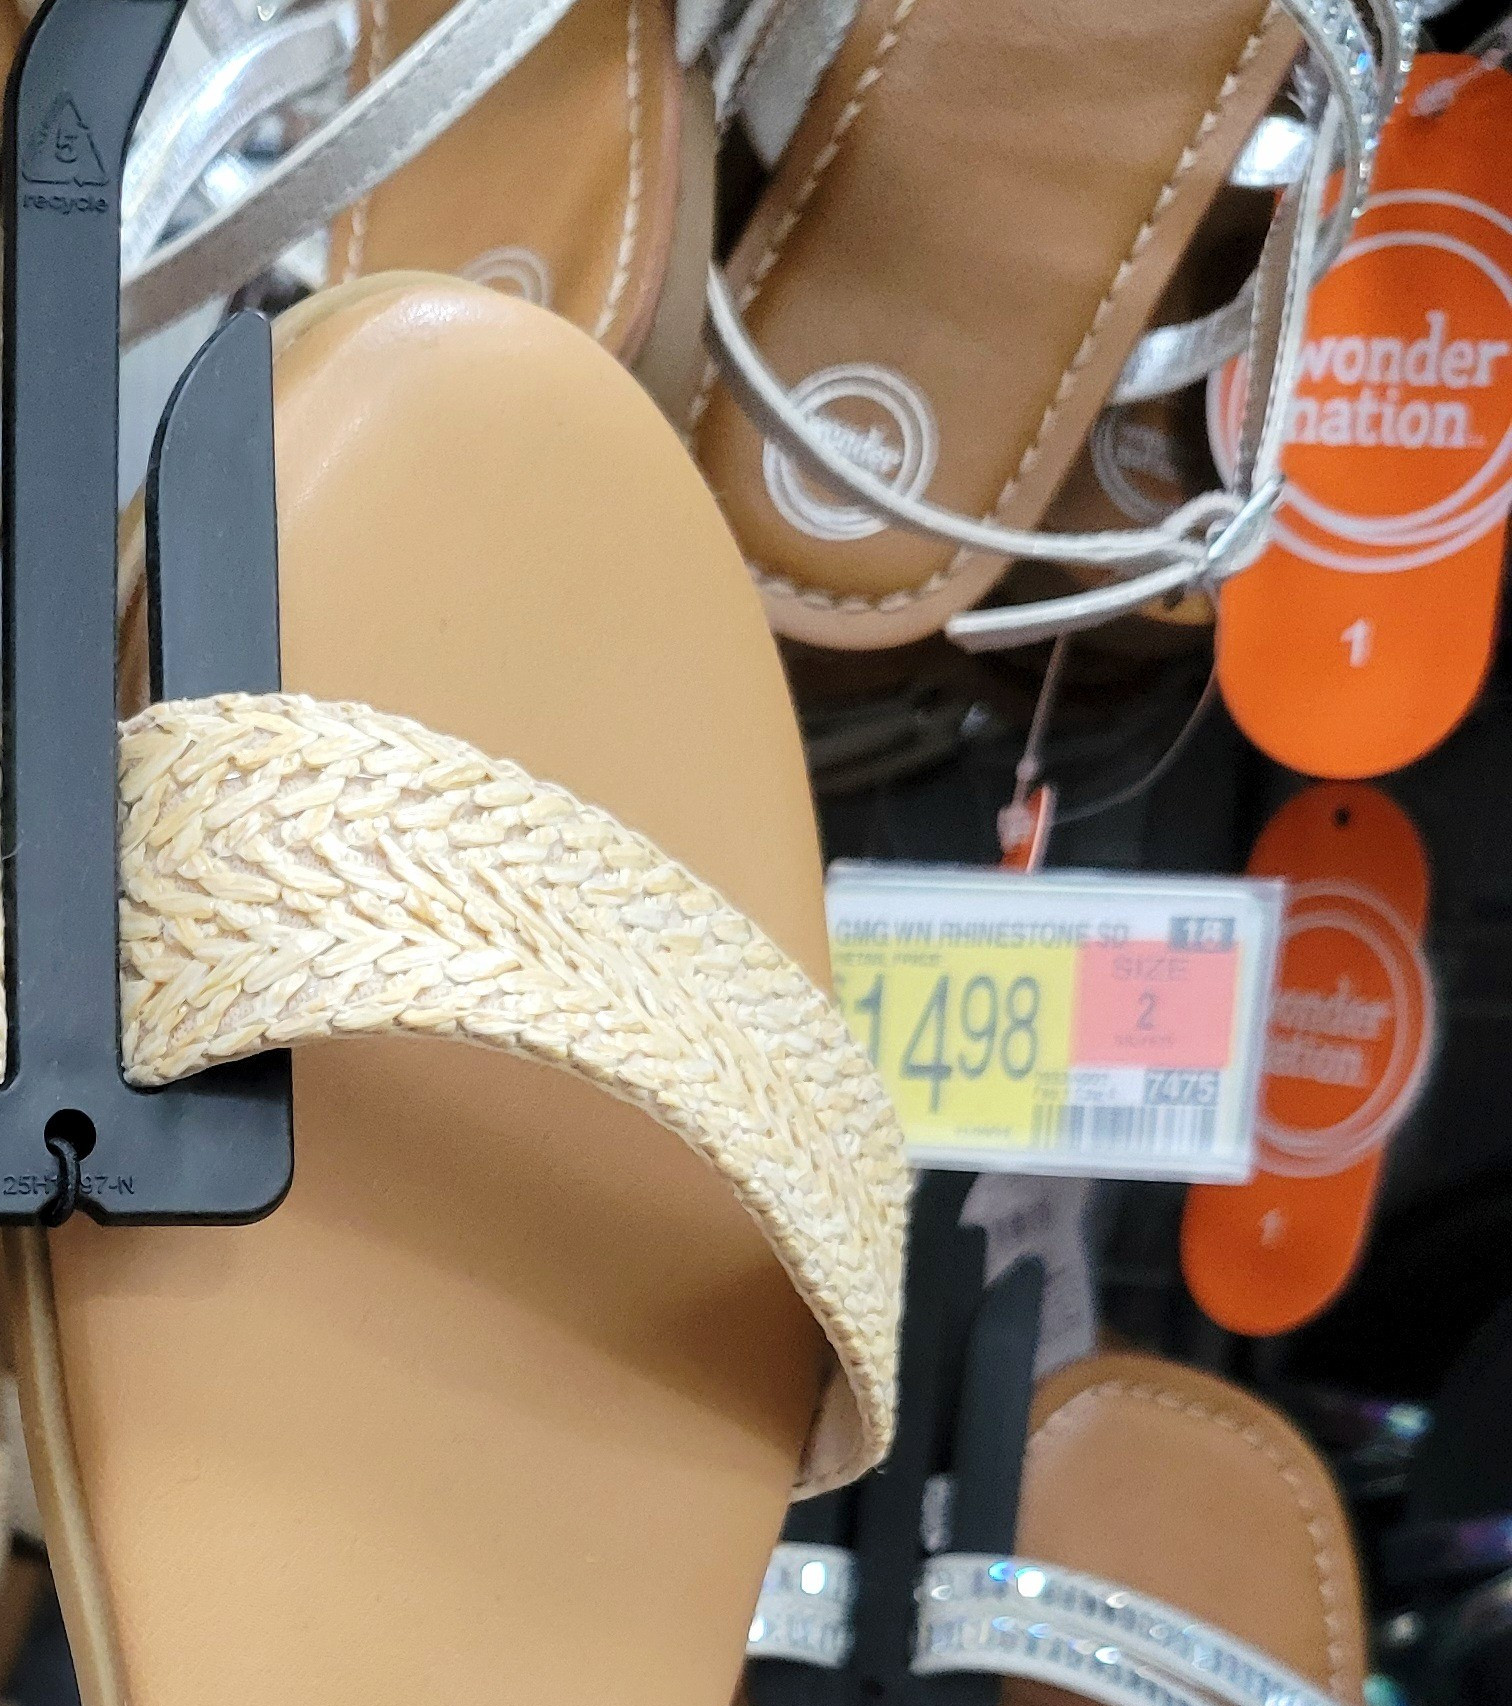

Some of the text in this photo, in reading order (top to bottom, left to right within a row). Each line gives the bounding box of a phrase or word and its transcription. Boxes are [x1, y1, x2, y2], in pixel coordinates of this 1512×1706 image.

[23, 195, 109, 215] recycle
[1294, 309, 1509, 390] wonder
[1342, 617, 1372, 667] 1
[893, 919, 934, 946] WN
[938, 920, 1090, 950] RHINESTONE
[1112, 955, 1189, 981] SIZE
[1136, 989, 1158, 1031] 2
[1144, 1069, 1217, 1104] 7475
